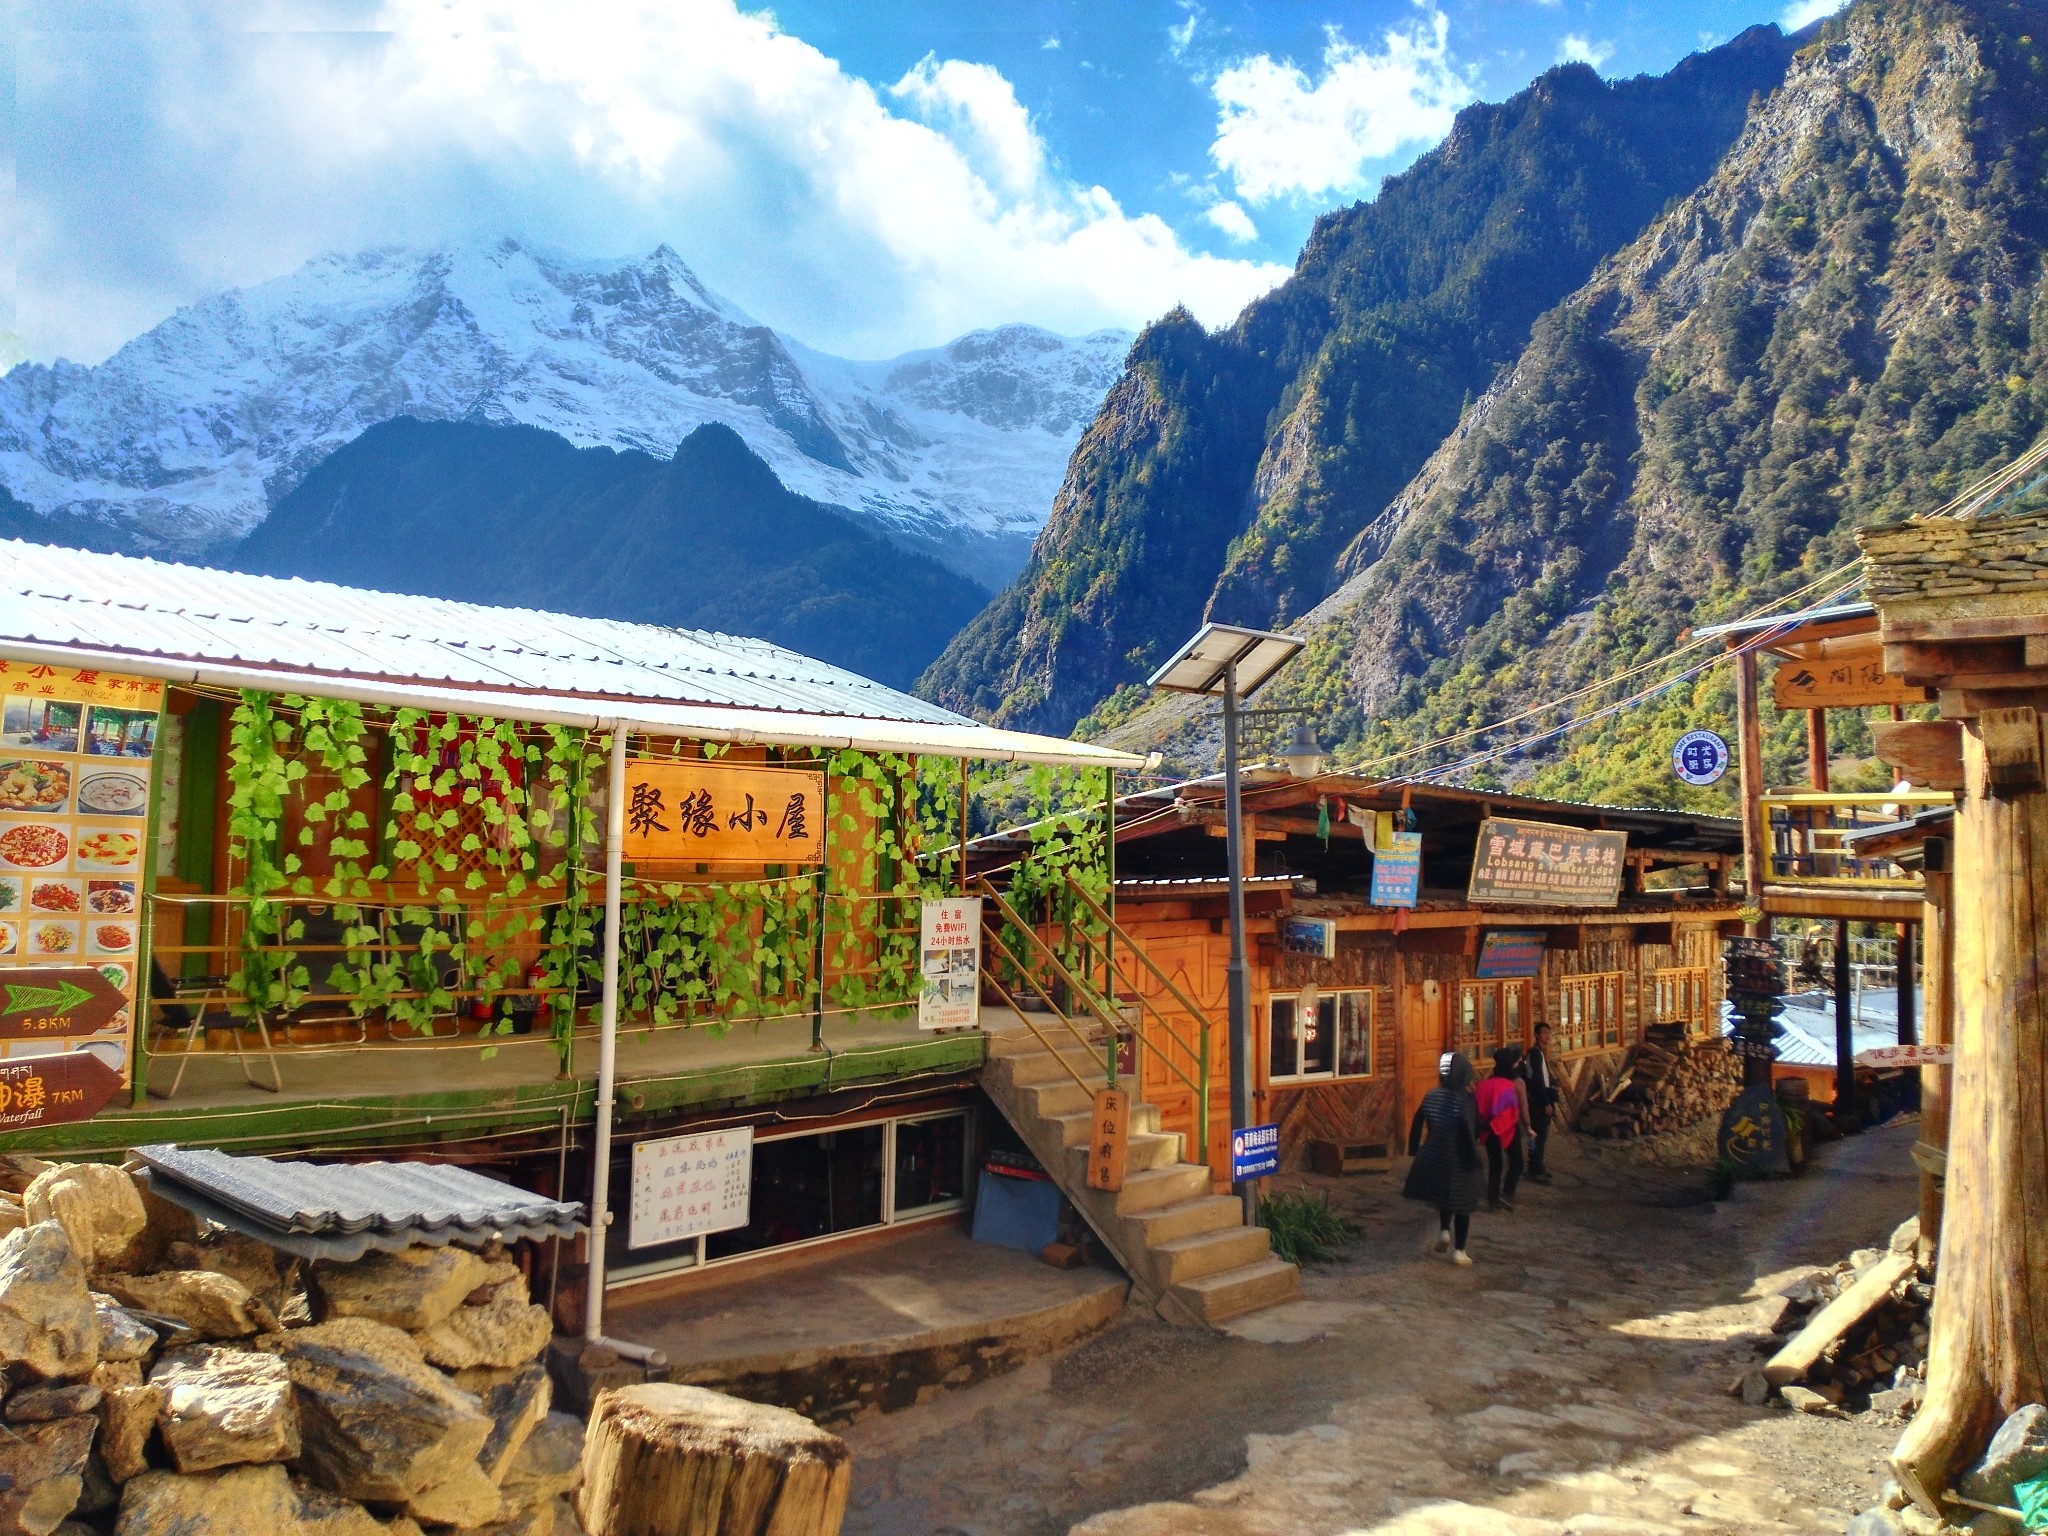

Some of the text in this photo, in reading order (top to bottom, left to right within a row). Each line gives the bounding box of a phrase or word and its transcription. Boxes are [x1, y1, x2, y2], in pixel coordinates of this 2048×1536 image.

[13, 681, 55, 695] 营业
[105, 678, 162, 694] 家常菜
[1676, 732, 1724, 754] TIME RESTAURANT
[627, 782, 809, 839] 聚缘小屋
[1487, 856, 1534, 871] Lobsang
[941, 909, 962, 920] 住宿
[935, 922, 967, 933] 免费WIFI
[930, 935, 971, 946] 24小时热水
[22, 1017, 71, 1031] 5.8KM
[51, 1088, 84, 1105] 7KM
